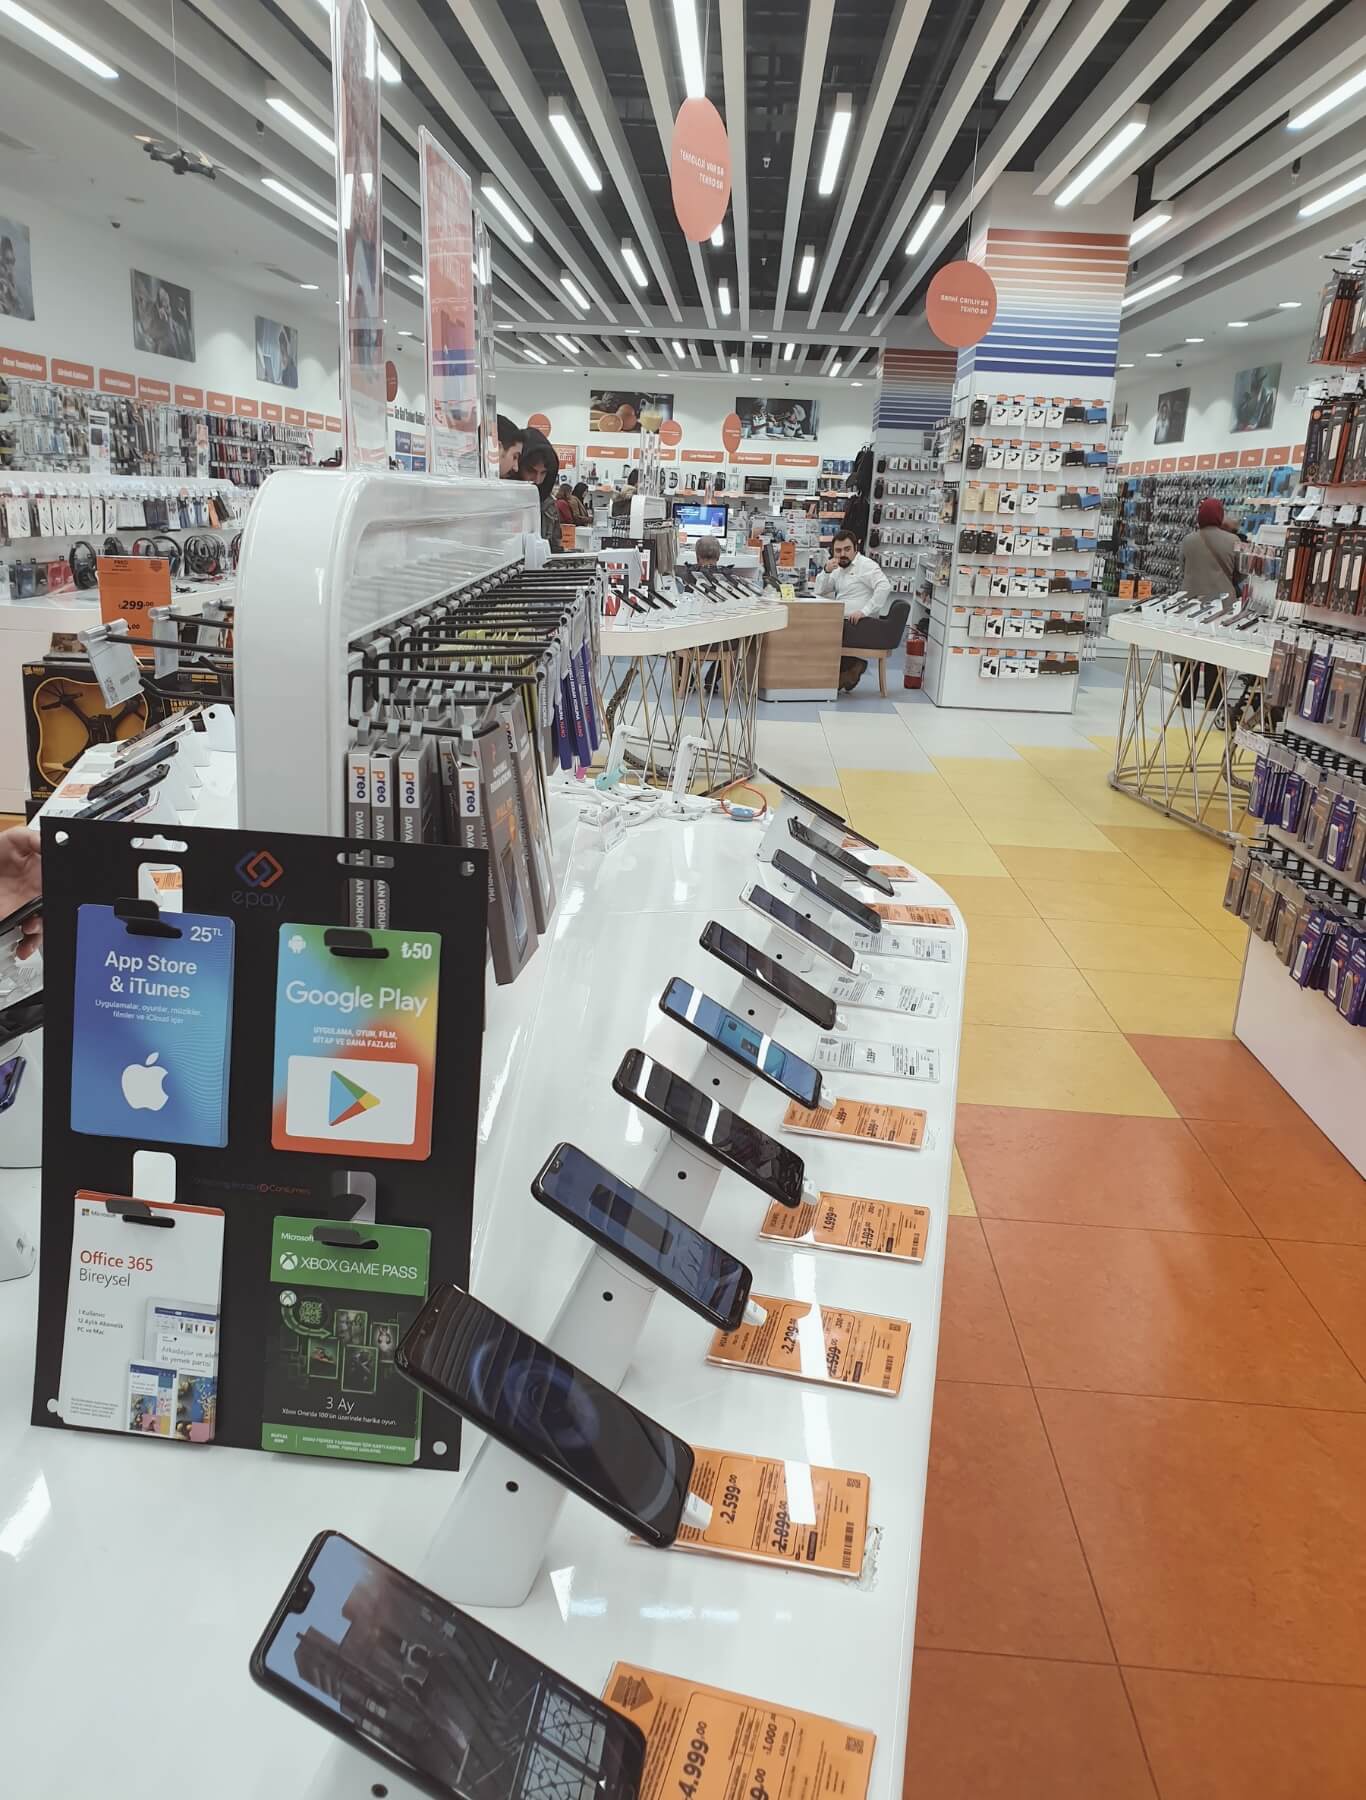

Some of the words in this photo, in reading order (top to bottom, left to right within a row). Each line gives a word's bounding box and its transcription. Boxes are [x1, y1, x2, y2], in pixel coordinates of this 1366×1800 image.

[352, 766, 367, 799] preo
[372, 770, 386, 803] preo
[401, 771, 415, 804] preo
[462, 780, 475, 813] preo
[231, 889, 287, 912] epay
[355, 896, 364, 928] KORUM
[104, 950, 143, 973] App
[146, 954, 198, 975] Store
[109, 975, 124, 992] &
[129, 976, 191, 999] iTunes
[286, 980, 373, 1013] Google
[379, 986, 429, 1017] Play
[281, 1232, 314, 1242] Microsoft
[80, 1249, 124, 1268] Office
[127, 1255, 154, 1272] 365
[300, 1257, 339, 1272] XBOX
[339, 1261, 380, 1276] GAME
[382, 1264, 418, 1280] PASS
[79, 1267, 131, 1289] Bireysel
[326, 1396, 334, 1409] 3
[337, 1397, 355, 1414] Ay
